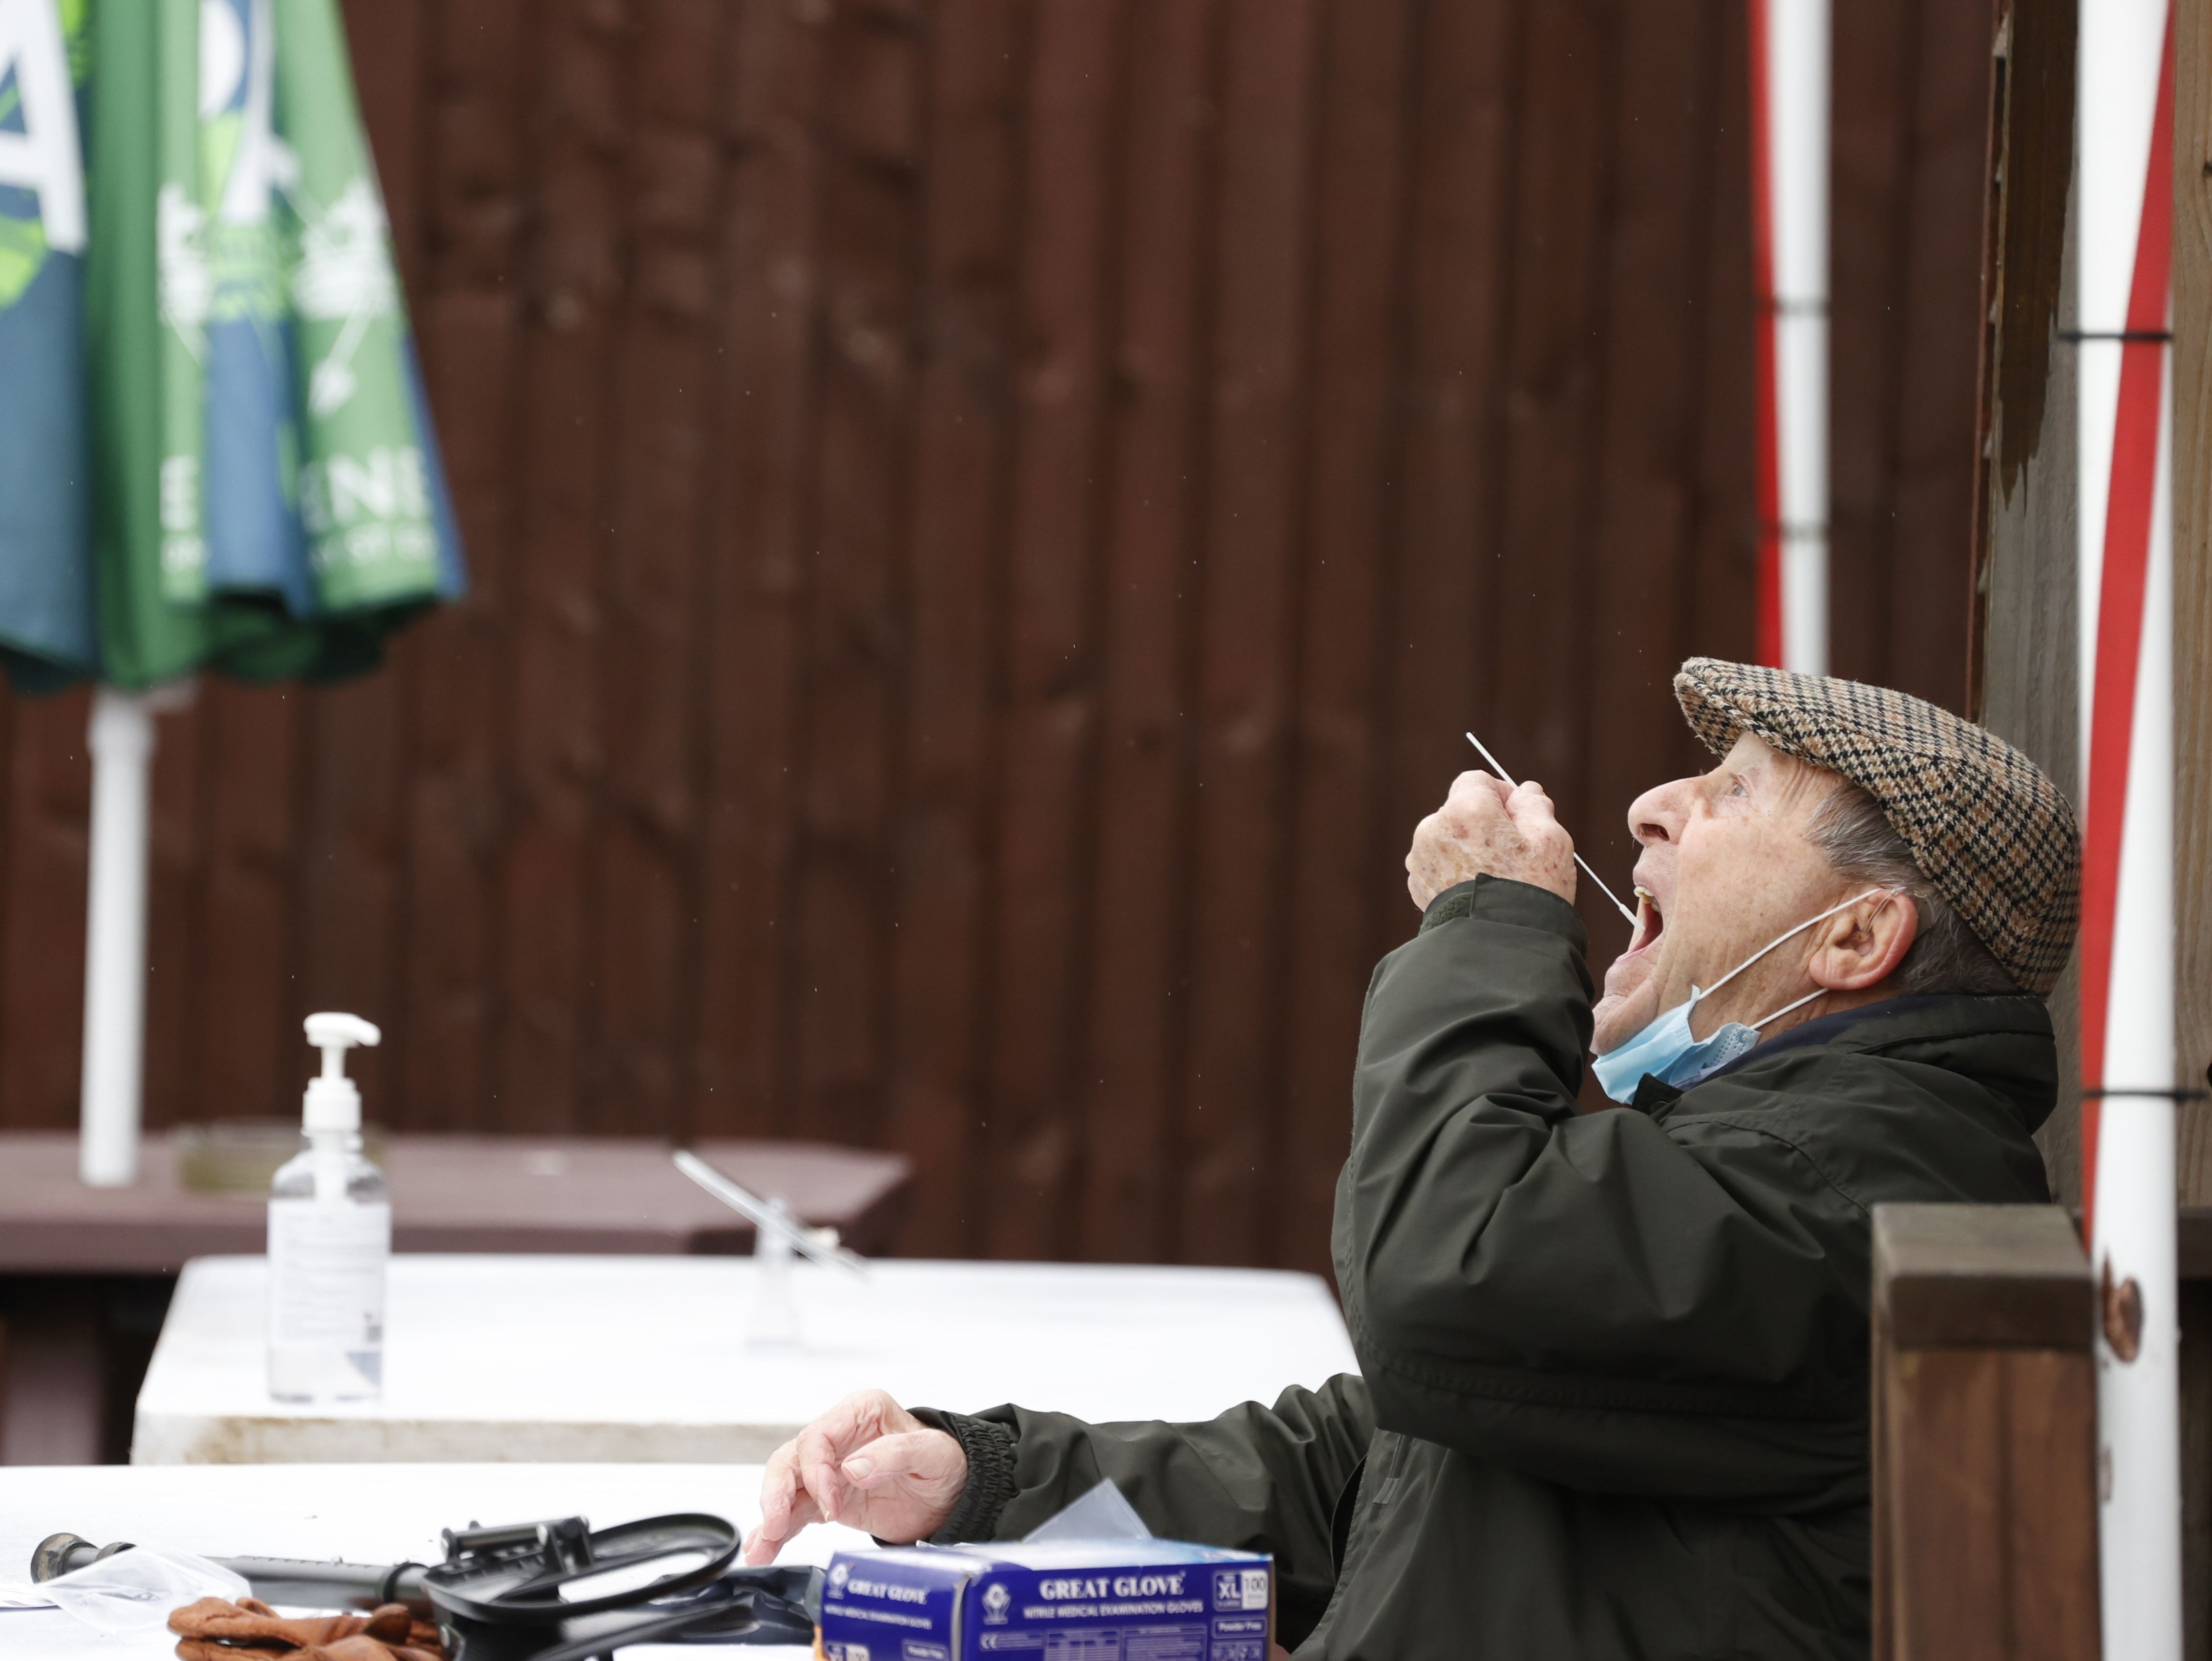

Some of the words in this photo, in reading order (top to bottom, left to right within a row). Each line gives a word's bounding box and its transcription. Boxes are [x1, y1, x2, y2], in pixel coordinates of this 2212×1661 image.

[1039, 1577, 1110, 1600] GREAT
[1113, 1575, 1184, 1597] GLOVE
[1218, 1582, 1241, 1599] XL
[1244, 1577, 1267, 1592] 100
[1024, 1605, 1056, 1619] NITRILE
[1057, 1603, 1099, 1618] MEDICAL
[1099, 1601, 1165, 1616] EXAMINATION
[1166, 1599, 1204, 1614] GLOVES
